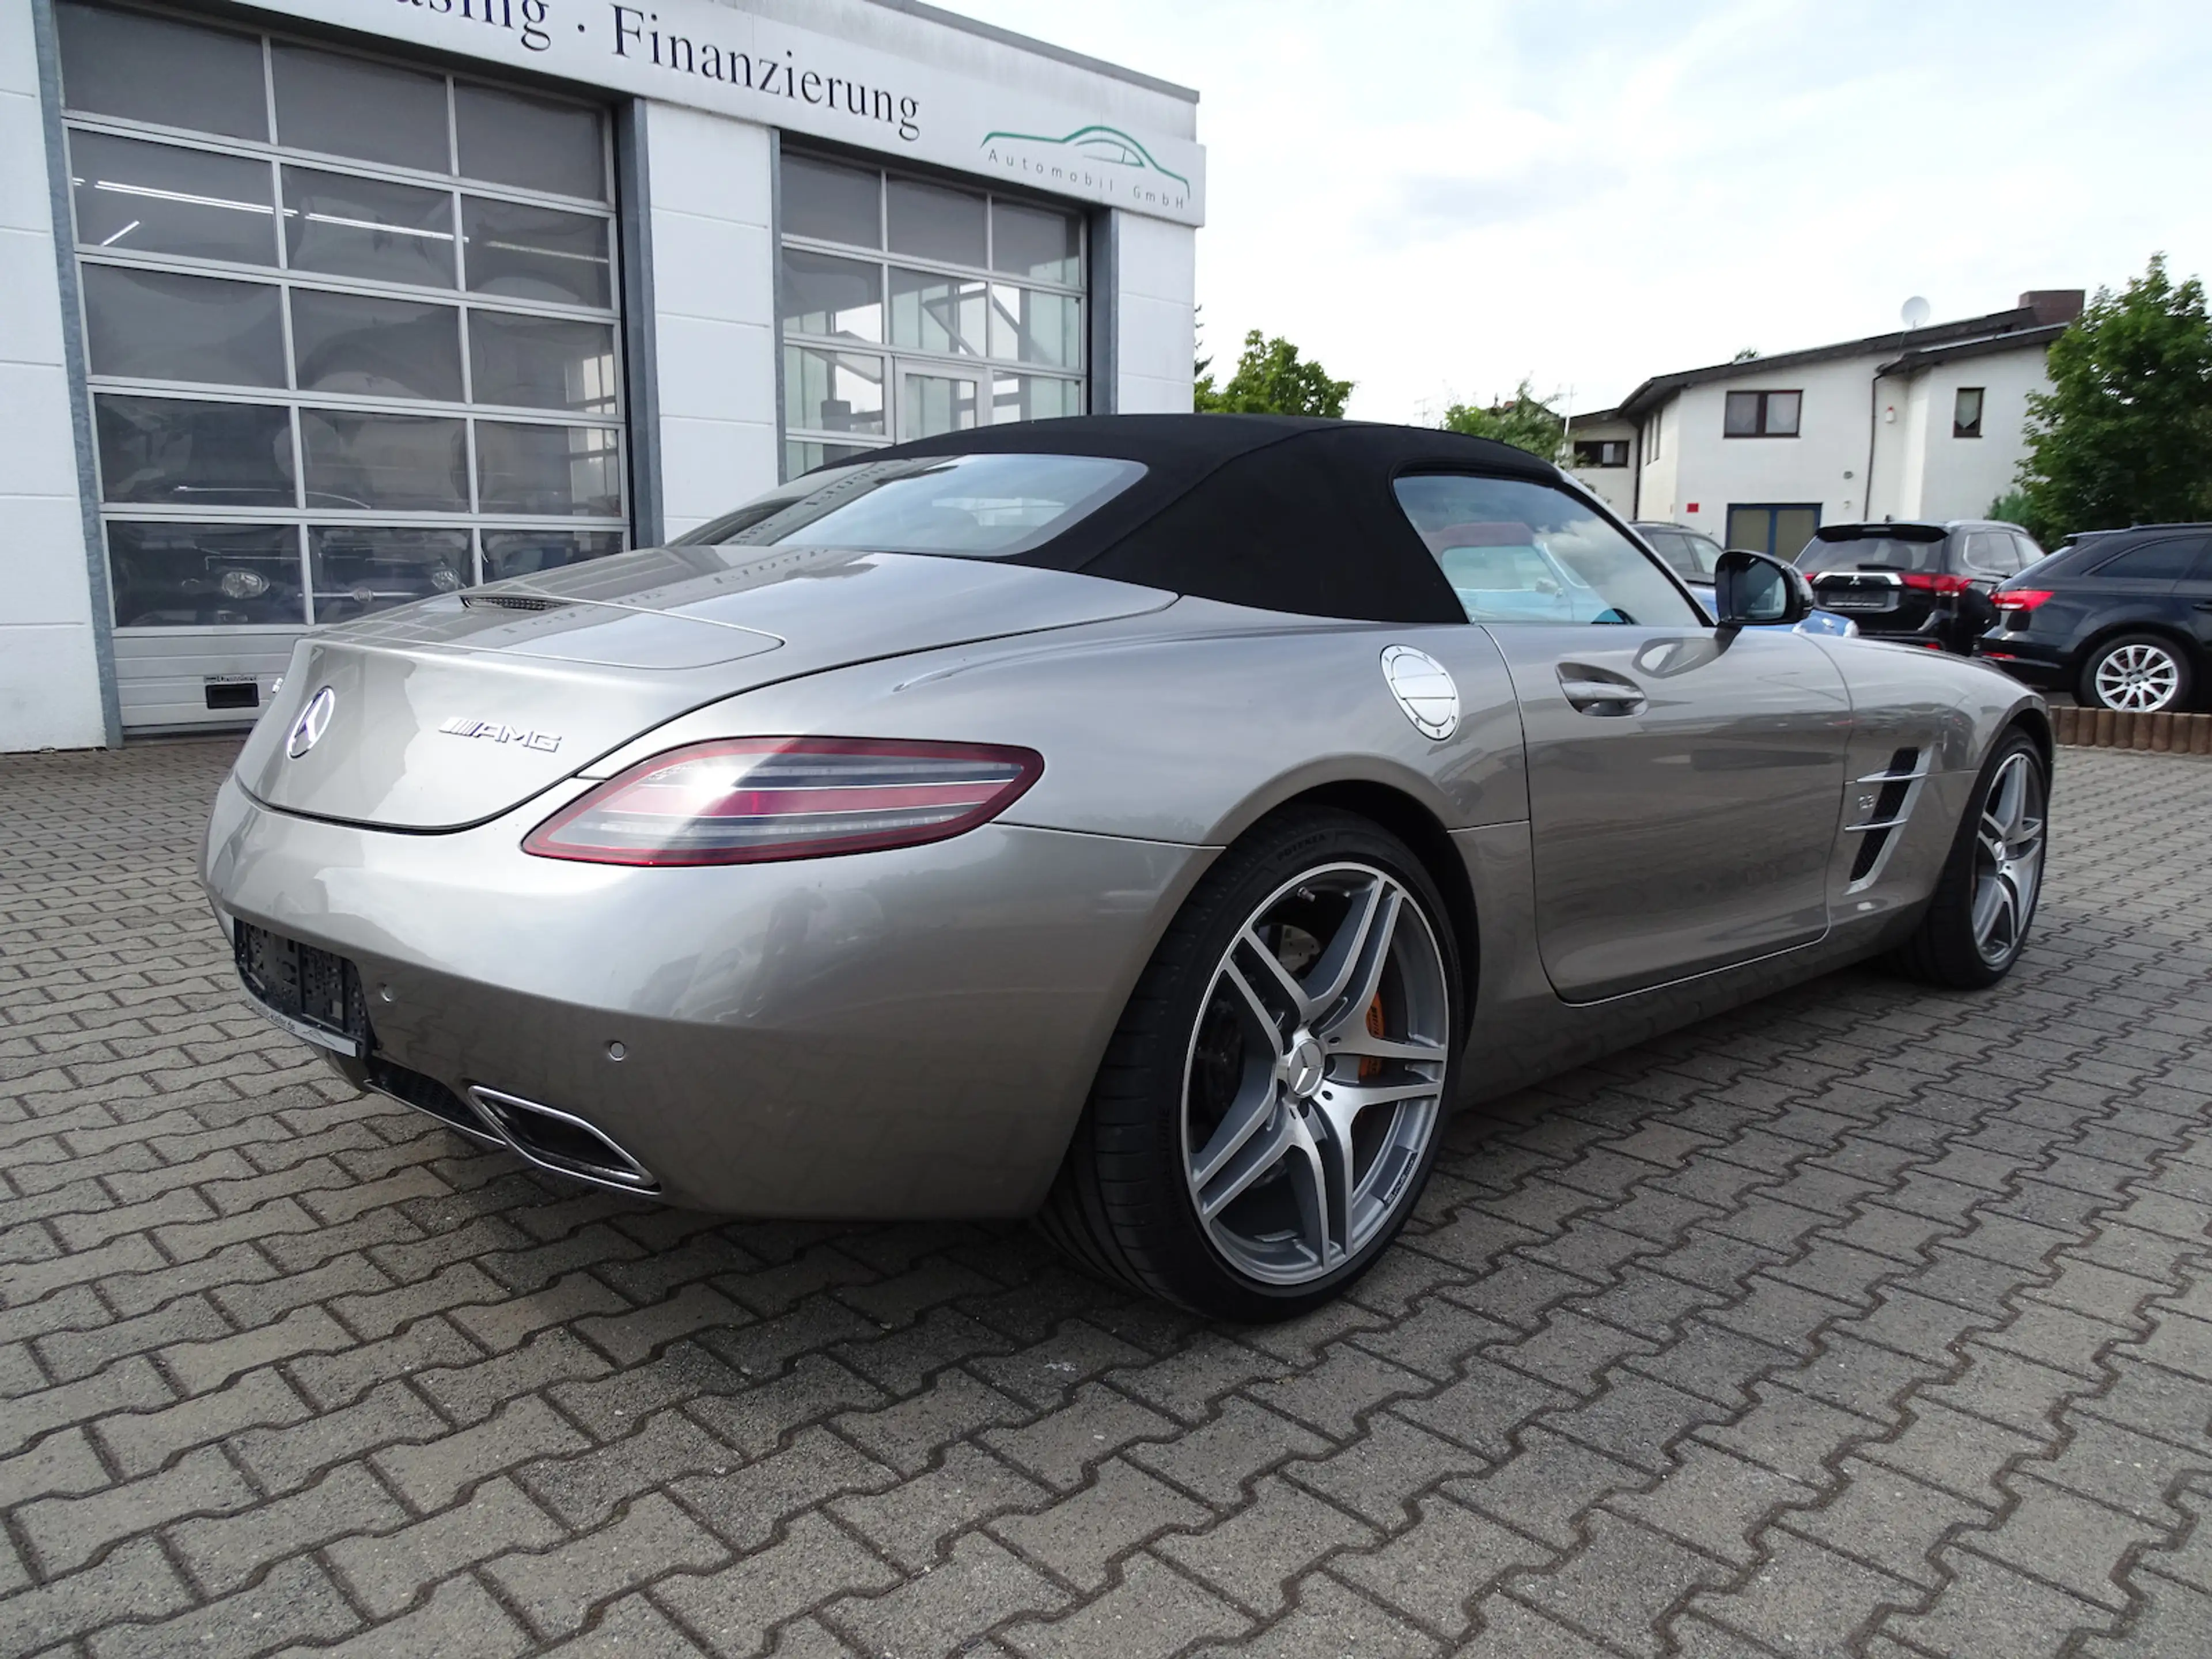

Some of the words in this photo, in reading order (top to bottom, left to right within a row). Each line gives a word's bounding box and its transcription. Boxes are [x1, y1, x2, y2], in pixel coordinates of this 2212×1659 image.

[609, 3, 921, 142] Finanzierung
[988, 149, 1113, 192] Automobil
[1133, 185, 1184, 209] GmbH
